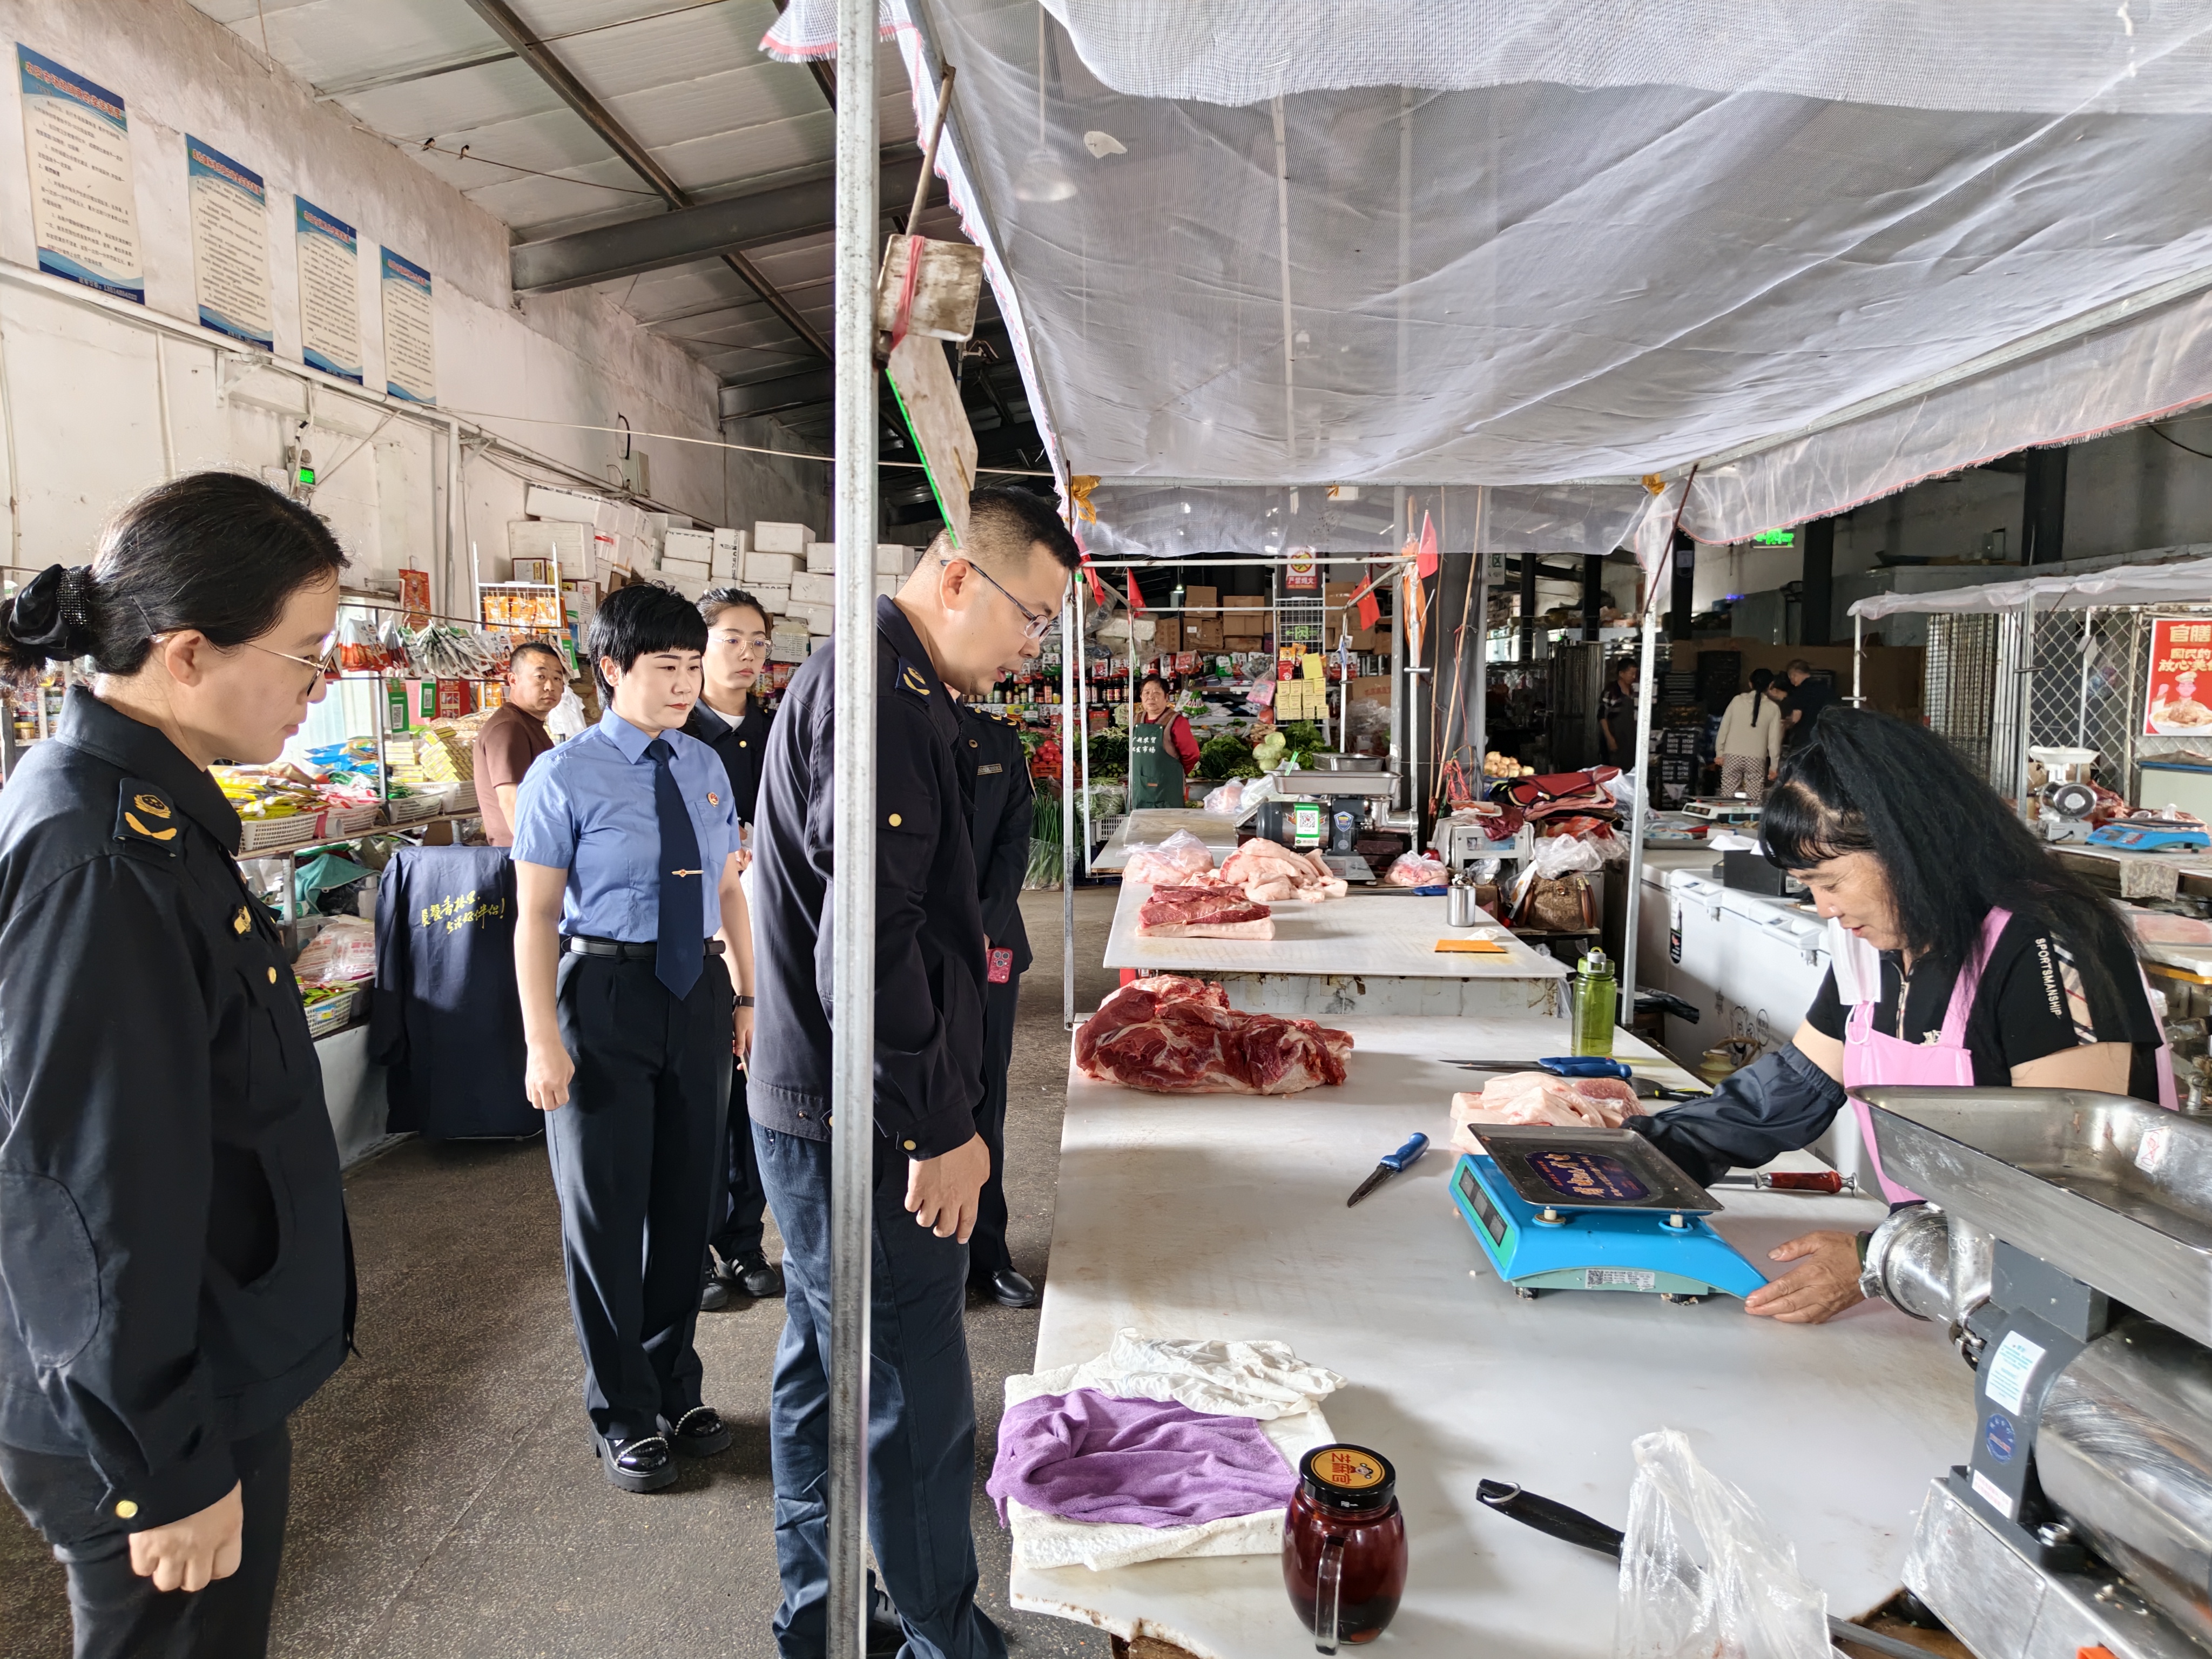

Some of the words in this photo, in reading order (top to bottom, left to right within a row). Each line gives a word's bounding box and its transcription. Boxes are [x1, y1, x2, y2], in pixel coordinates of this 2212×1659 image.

[2035, 938, 2062, 1015] SPORTSMANSHIP
[1332, 1452, 1352, 1485] 芝麻官
